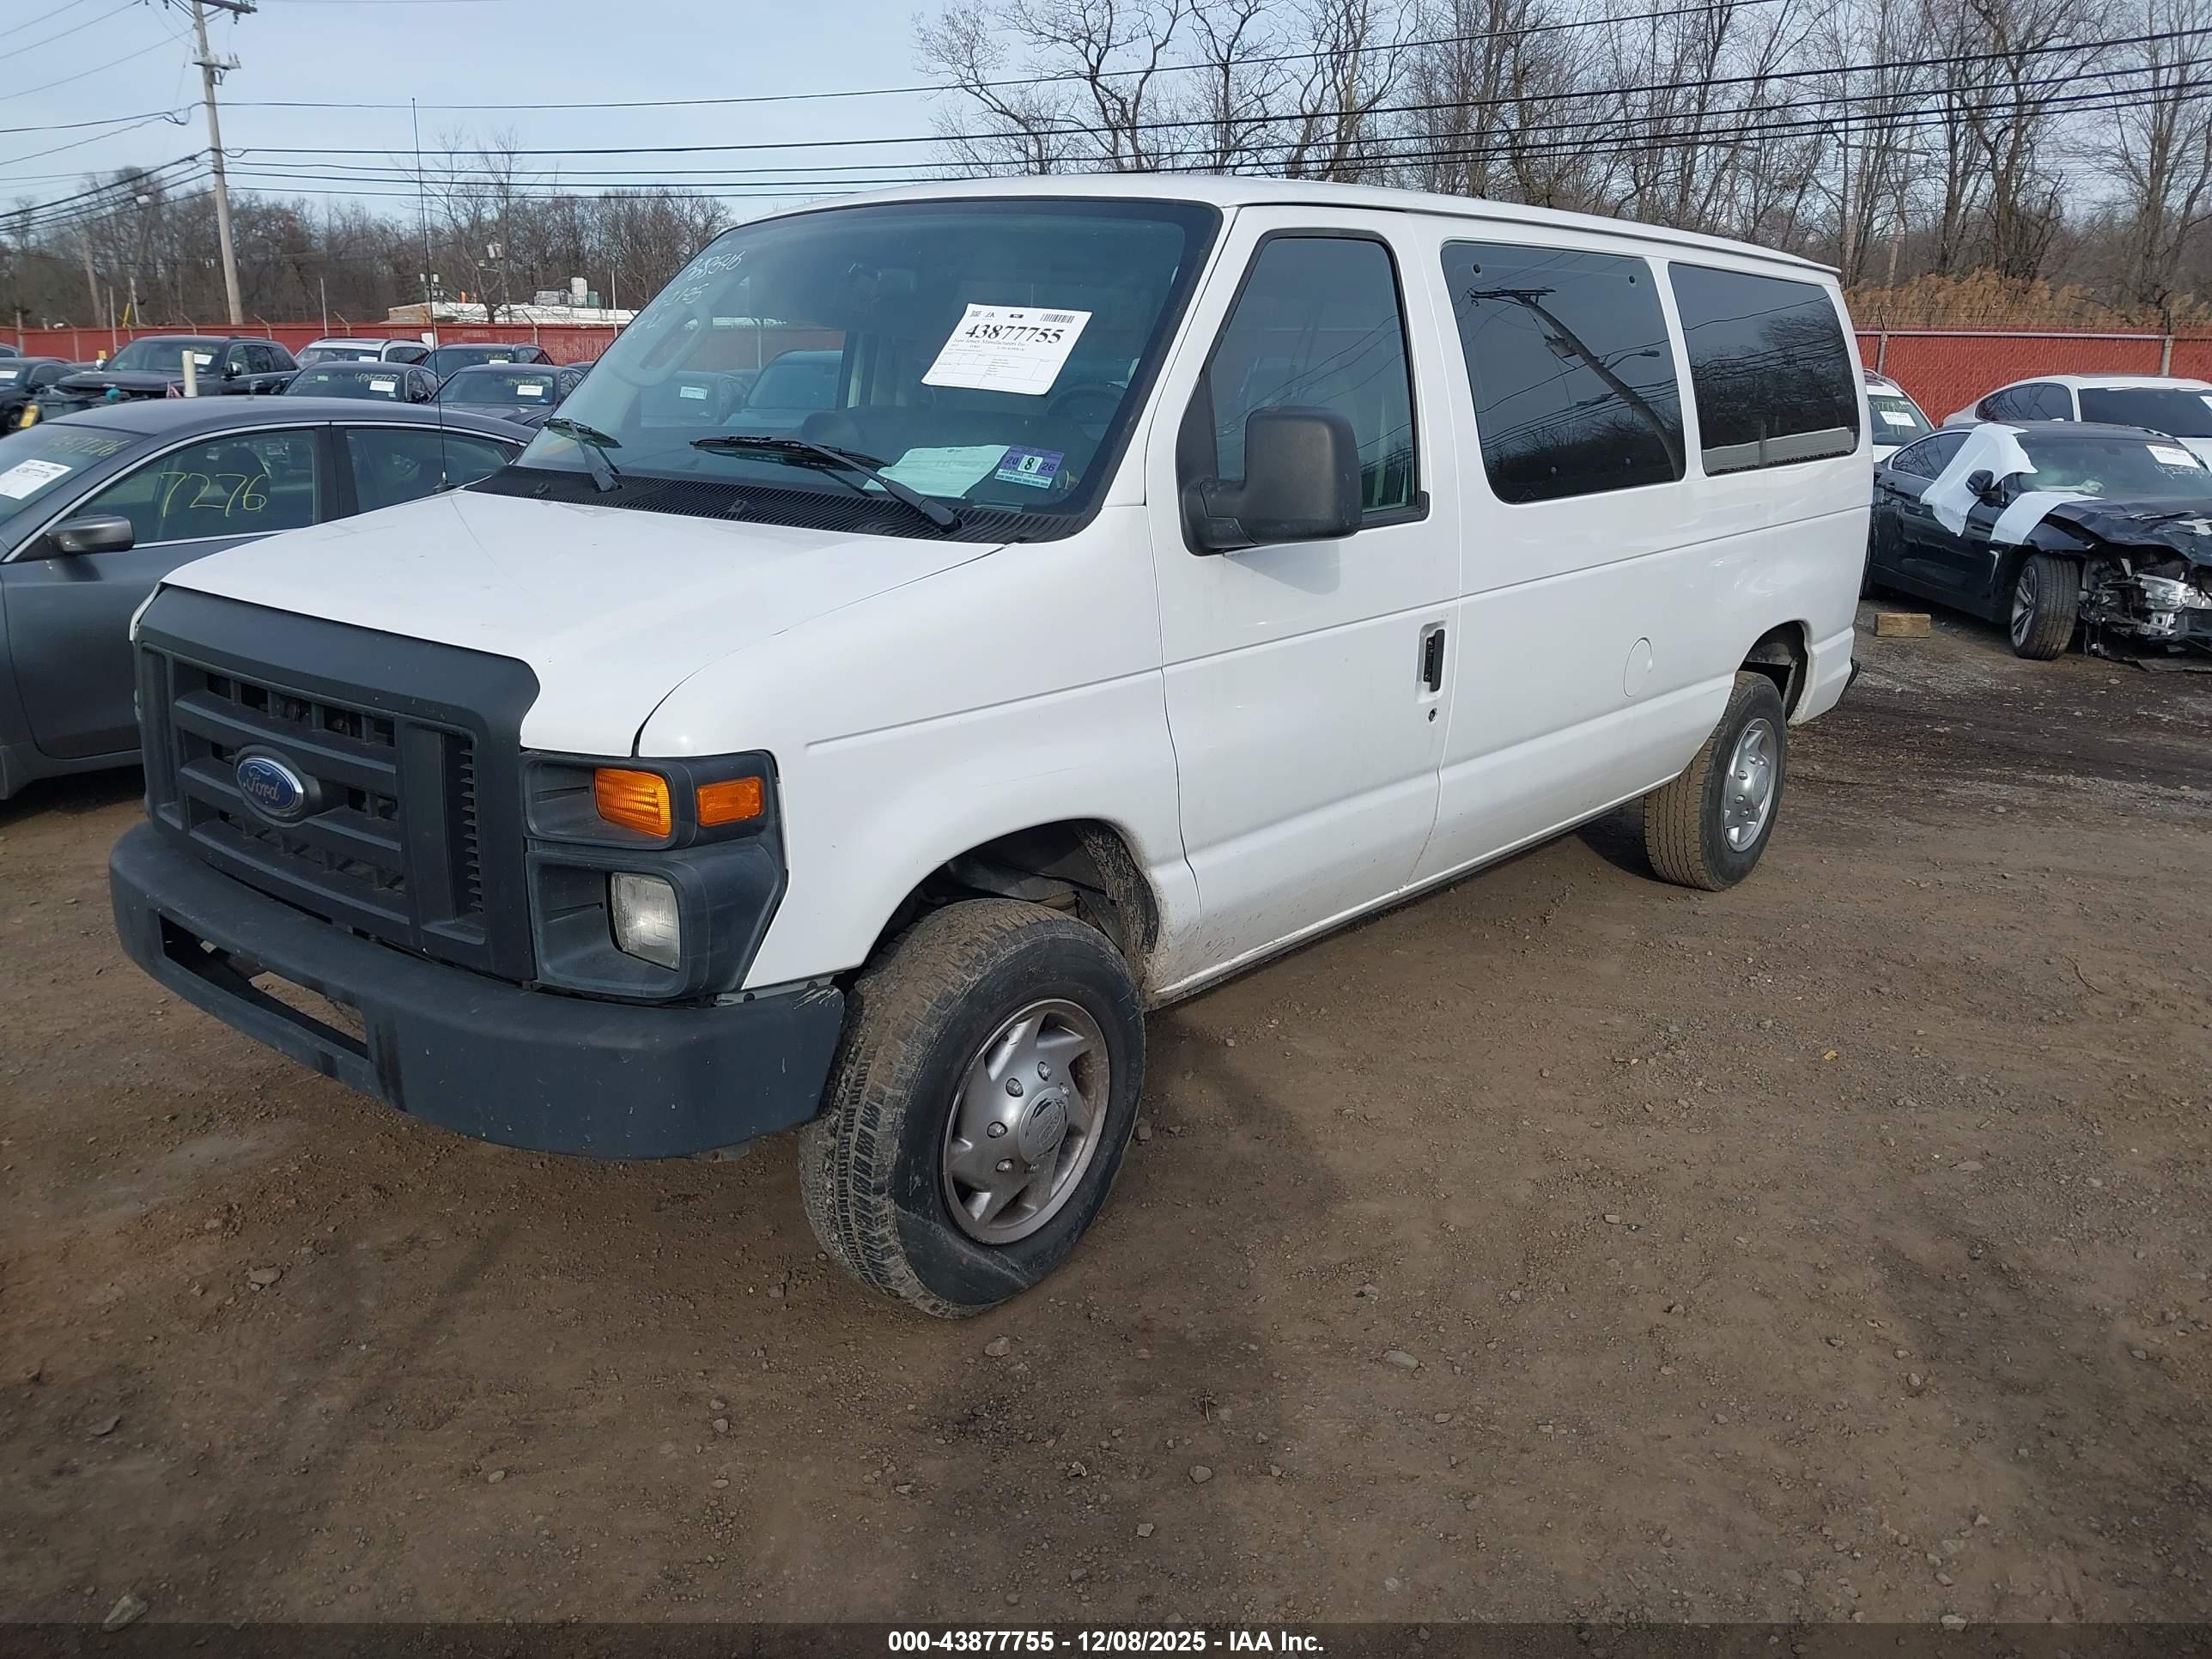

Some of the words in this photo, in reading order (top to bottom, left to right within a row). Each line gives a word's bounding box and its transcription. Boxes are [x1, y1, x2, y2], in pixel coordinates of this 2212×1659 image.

[965, 324, 1065, 343] 43877755
[1006, 456, 1020, 465] 20
[1024, 457, 1035, 471] 8
[1041, 462, 1056, 471] 26
[158, 471, 268, 519] 7276
[246, 765, 281, 801] Ford
